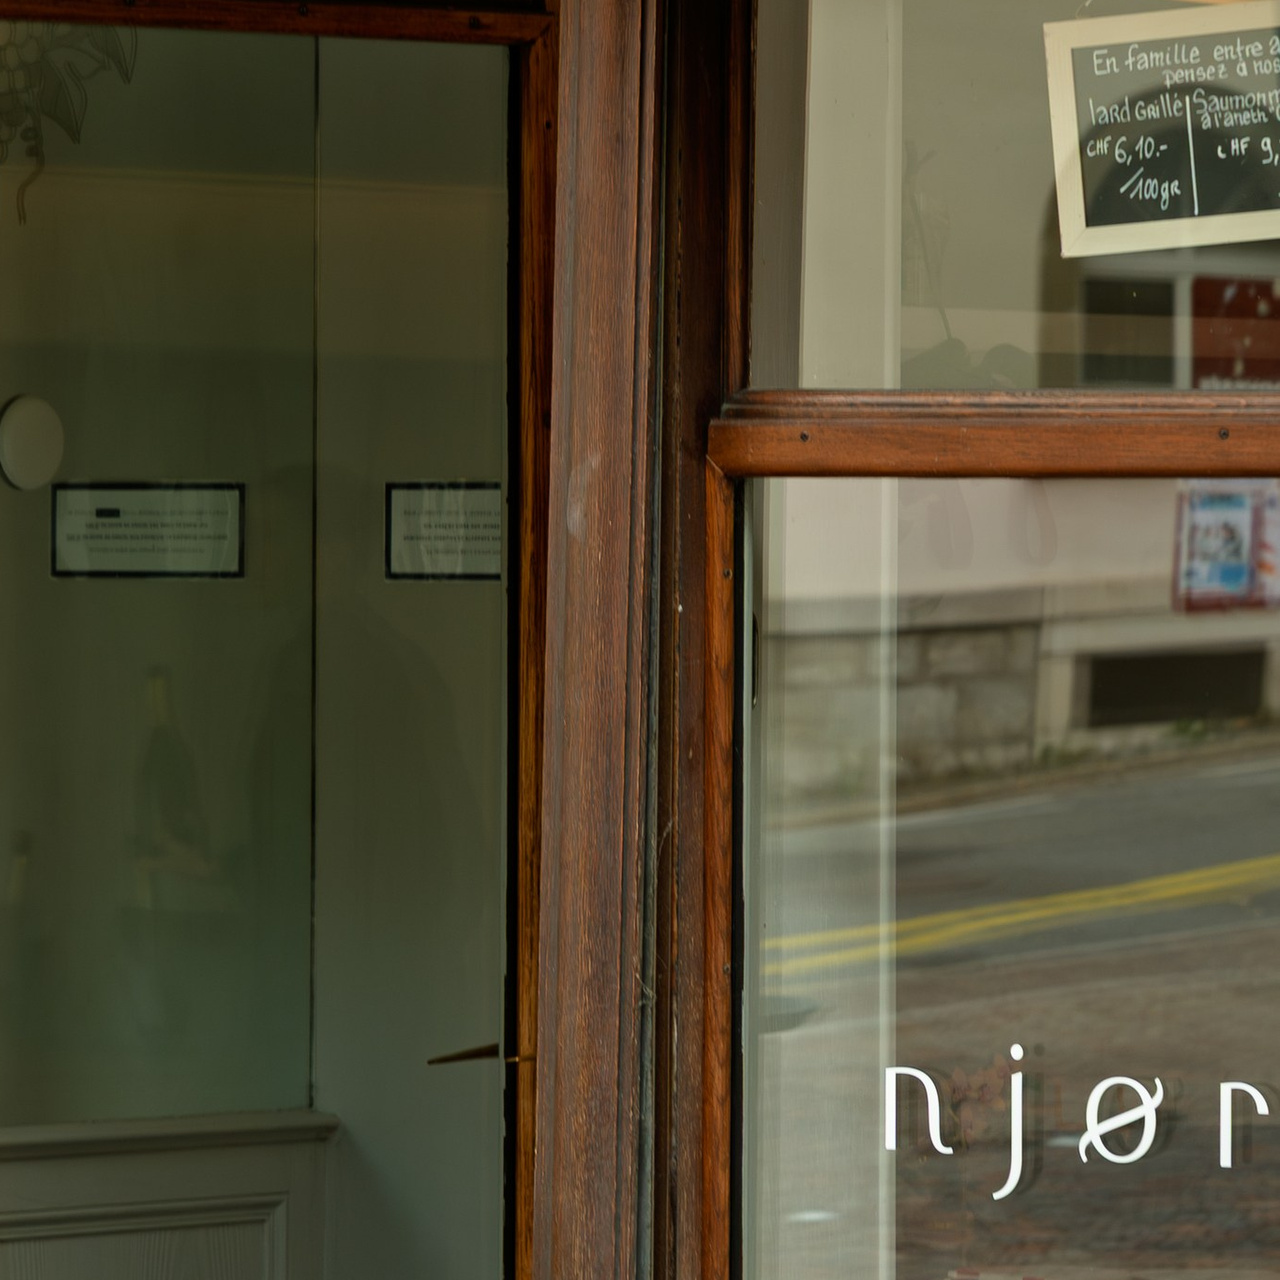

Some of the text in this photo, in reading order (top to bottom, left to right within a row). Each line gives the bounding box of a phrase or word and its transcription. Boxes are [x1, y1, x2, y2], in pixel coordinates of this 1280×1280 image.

[1092, 49, 1120, 75] En
[1124, 43, 1201, 72] famille
[1213, 36, 1264, 61] entre
[1162, 65, 1229, 89] pensez
[1086, 135, 1112, 158] CHF
[884, 1042, 1270, 1201] njør
